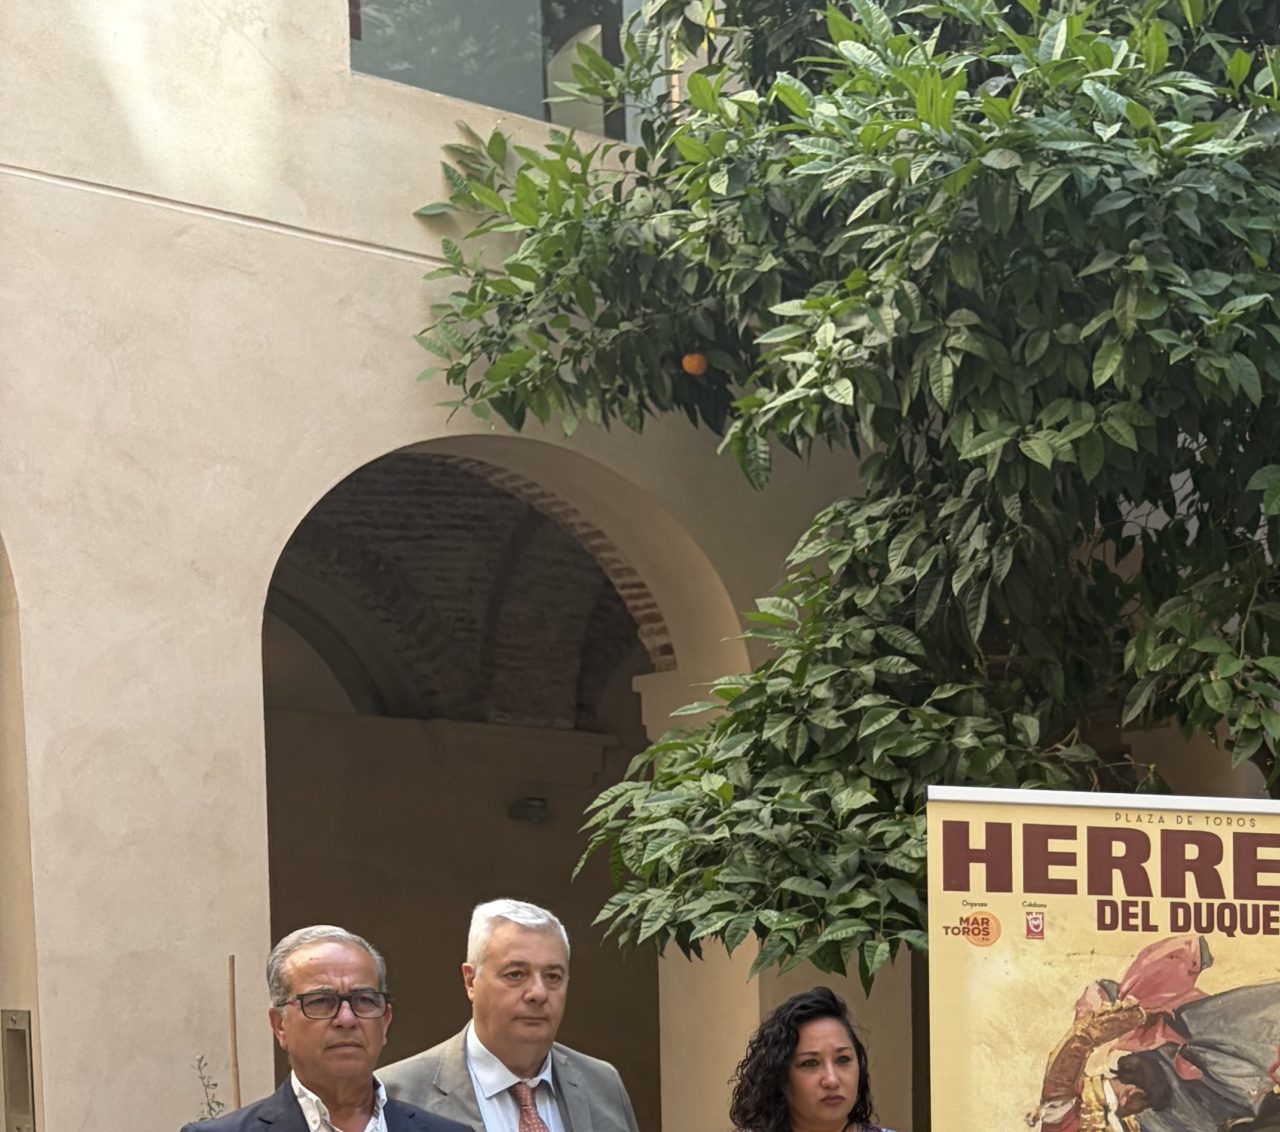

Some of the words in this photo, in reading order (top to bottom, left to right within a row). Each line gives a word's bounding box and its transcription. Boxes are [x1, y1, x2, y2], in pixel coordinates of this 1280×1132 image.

[1115, 813, 1164, 824] PLAZA
[1176, 815, 1193, 825] DE
[1205, 816, 1256, 827] TOROS
[959, 917, 990, 926] MAR
[1097, 900, 1158, 933] DEL
[1169, 901, 1280, 938] DUQUE
[942, 926, 990, 936] TOROS
